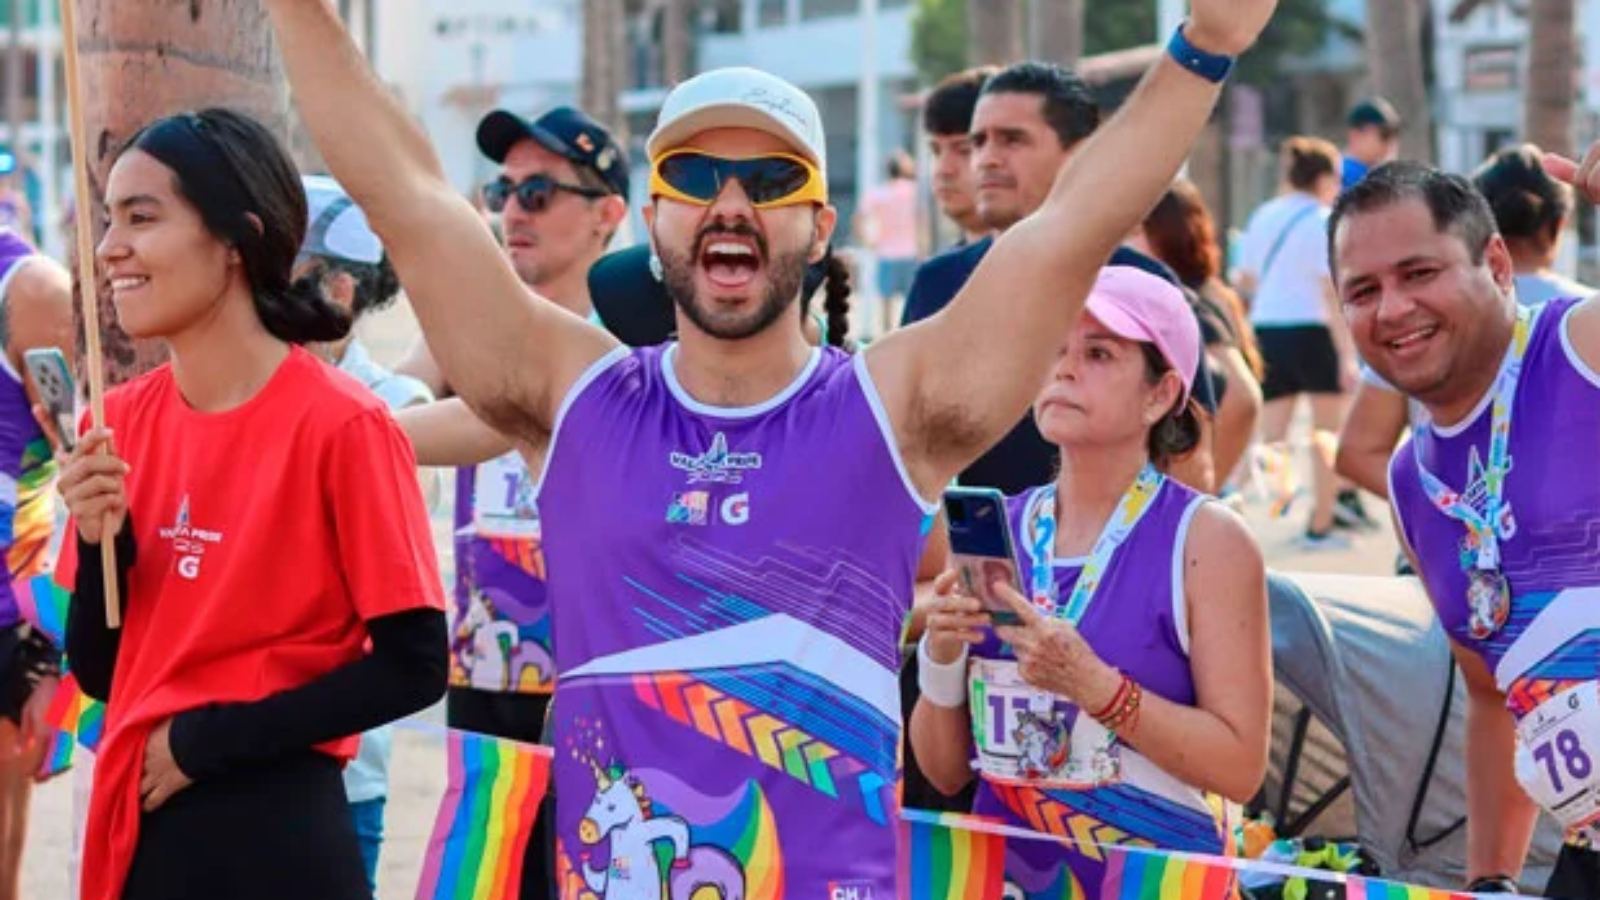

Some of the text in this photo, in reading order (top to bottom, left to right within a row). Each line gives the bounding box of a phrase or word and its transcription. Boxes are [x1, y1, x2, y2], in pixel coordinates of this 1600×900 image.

[721, 492, 749, 525] G
[178, 555, 200, 580] G
[1532, 729, 1592, 793] 78
